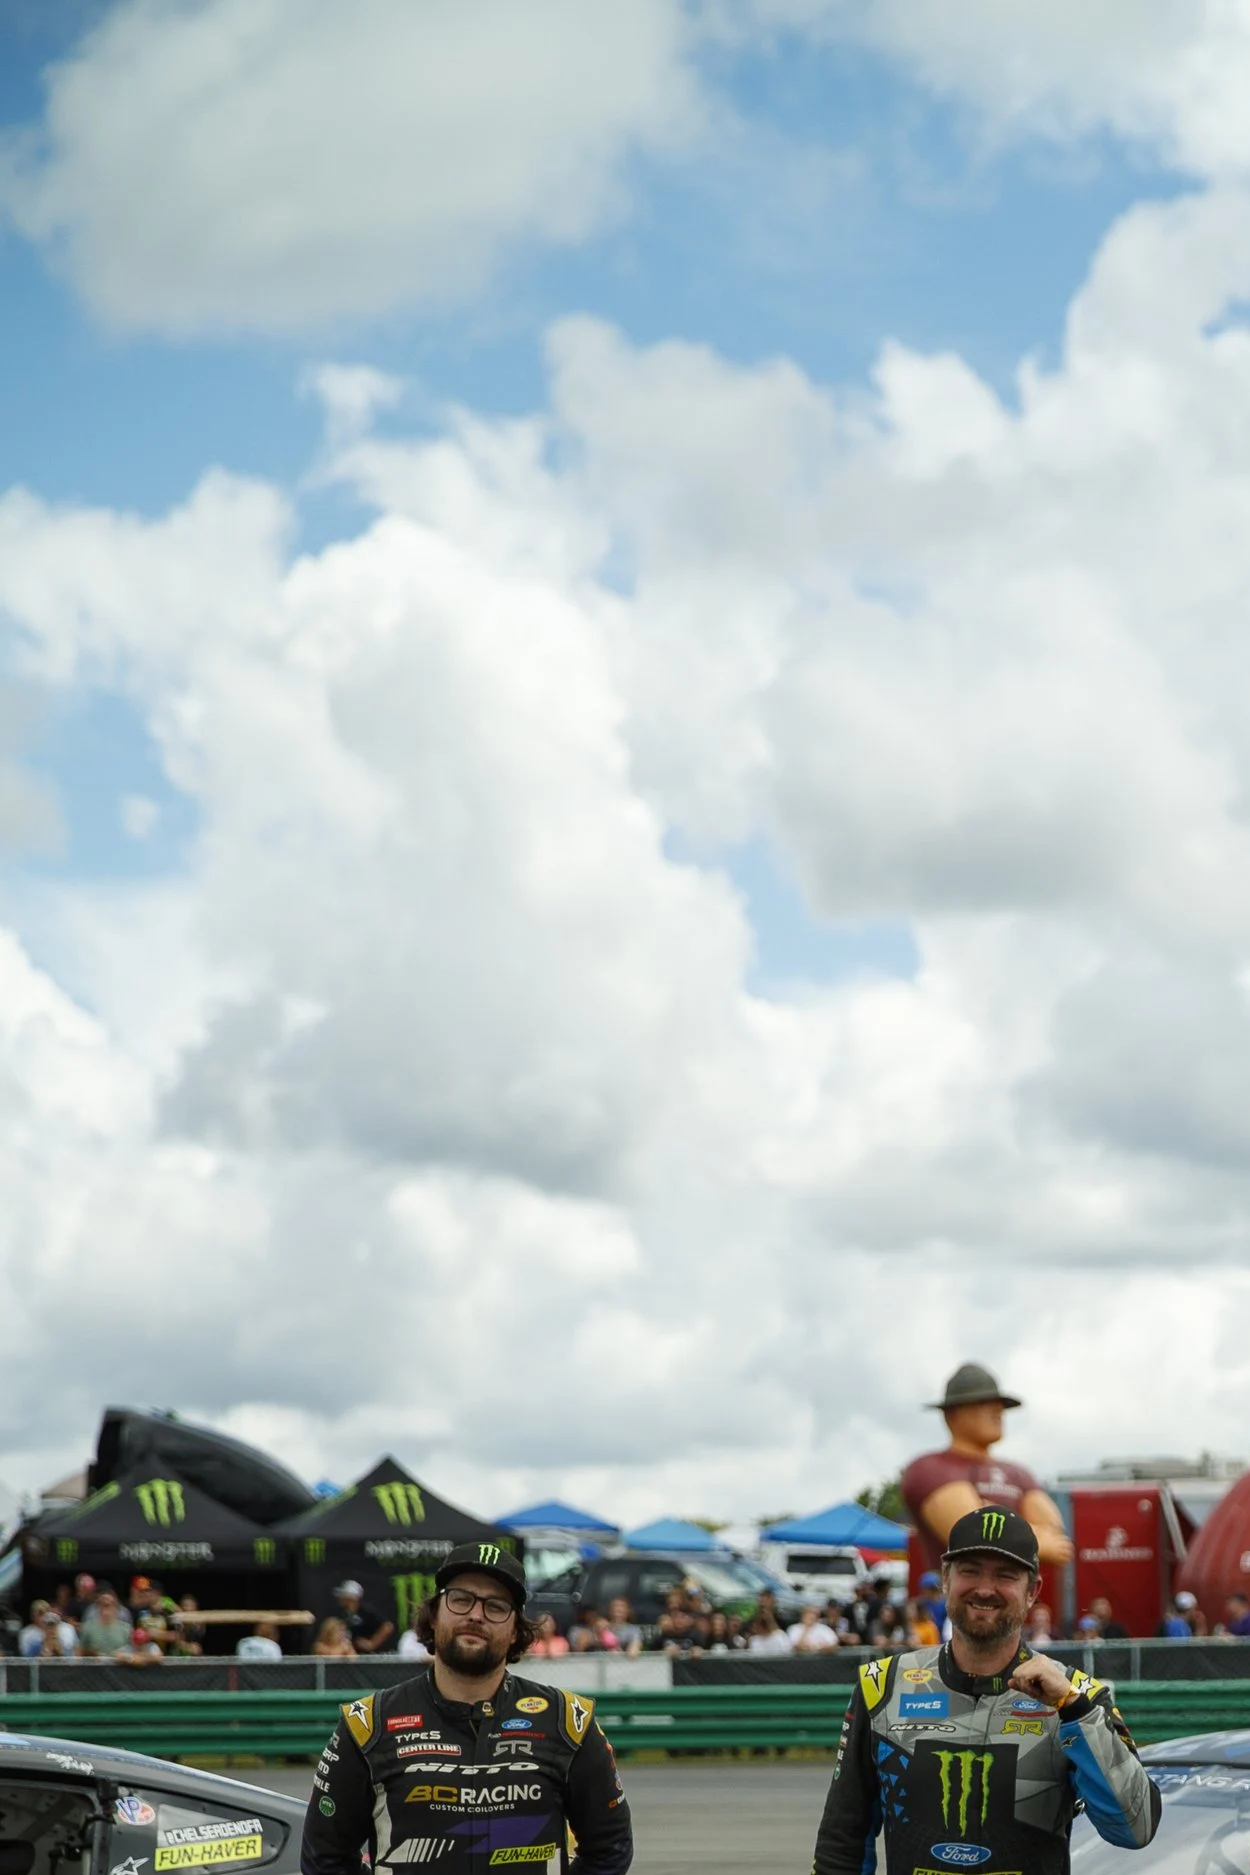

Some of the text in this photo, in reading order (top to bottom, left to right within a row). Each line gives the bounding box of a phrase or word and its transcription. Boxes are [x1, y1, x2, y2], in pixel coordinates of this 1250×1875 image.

[460, 1784, 541, 1804] RACING
[430, 1803, 515, 1813] CUSTOM COILOVERS
[158, 1840, 257, 1867] FUN-HAVER
[492, 1845, 555, 1863] FUN-HAVER
[942, 1845, 980, 1861] Ford
